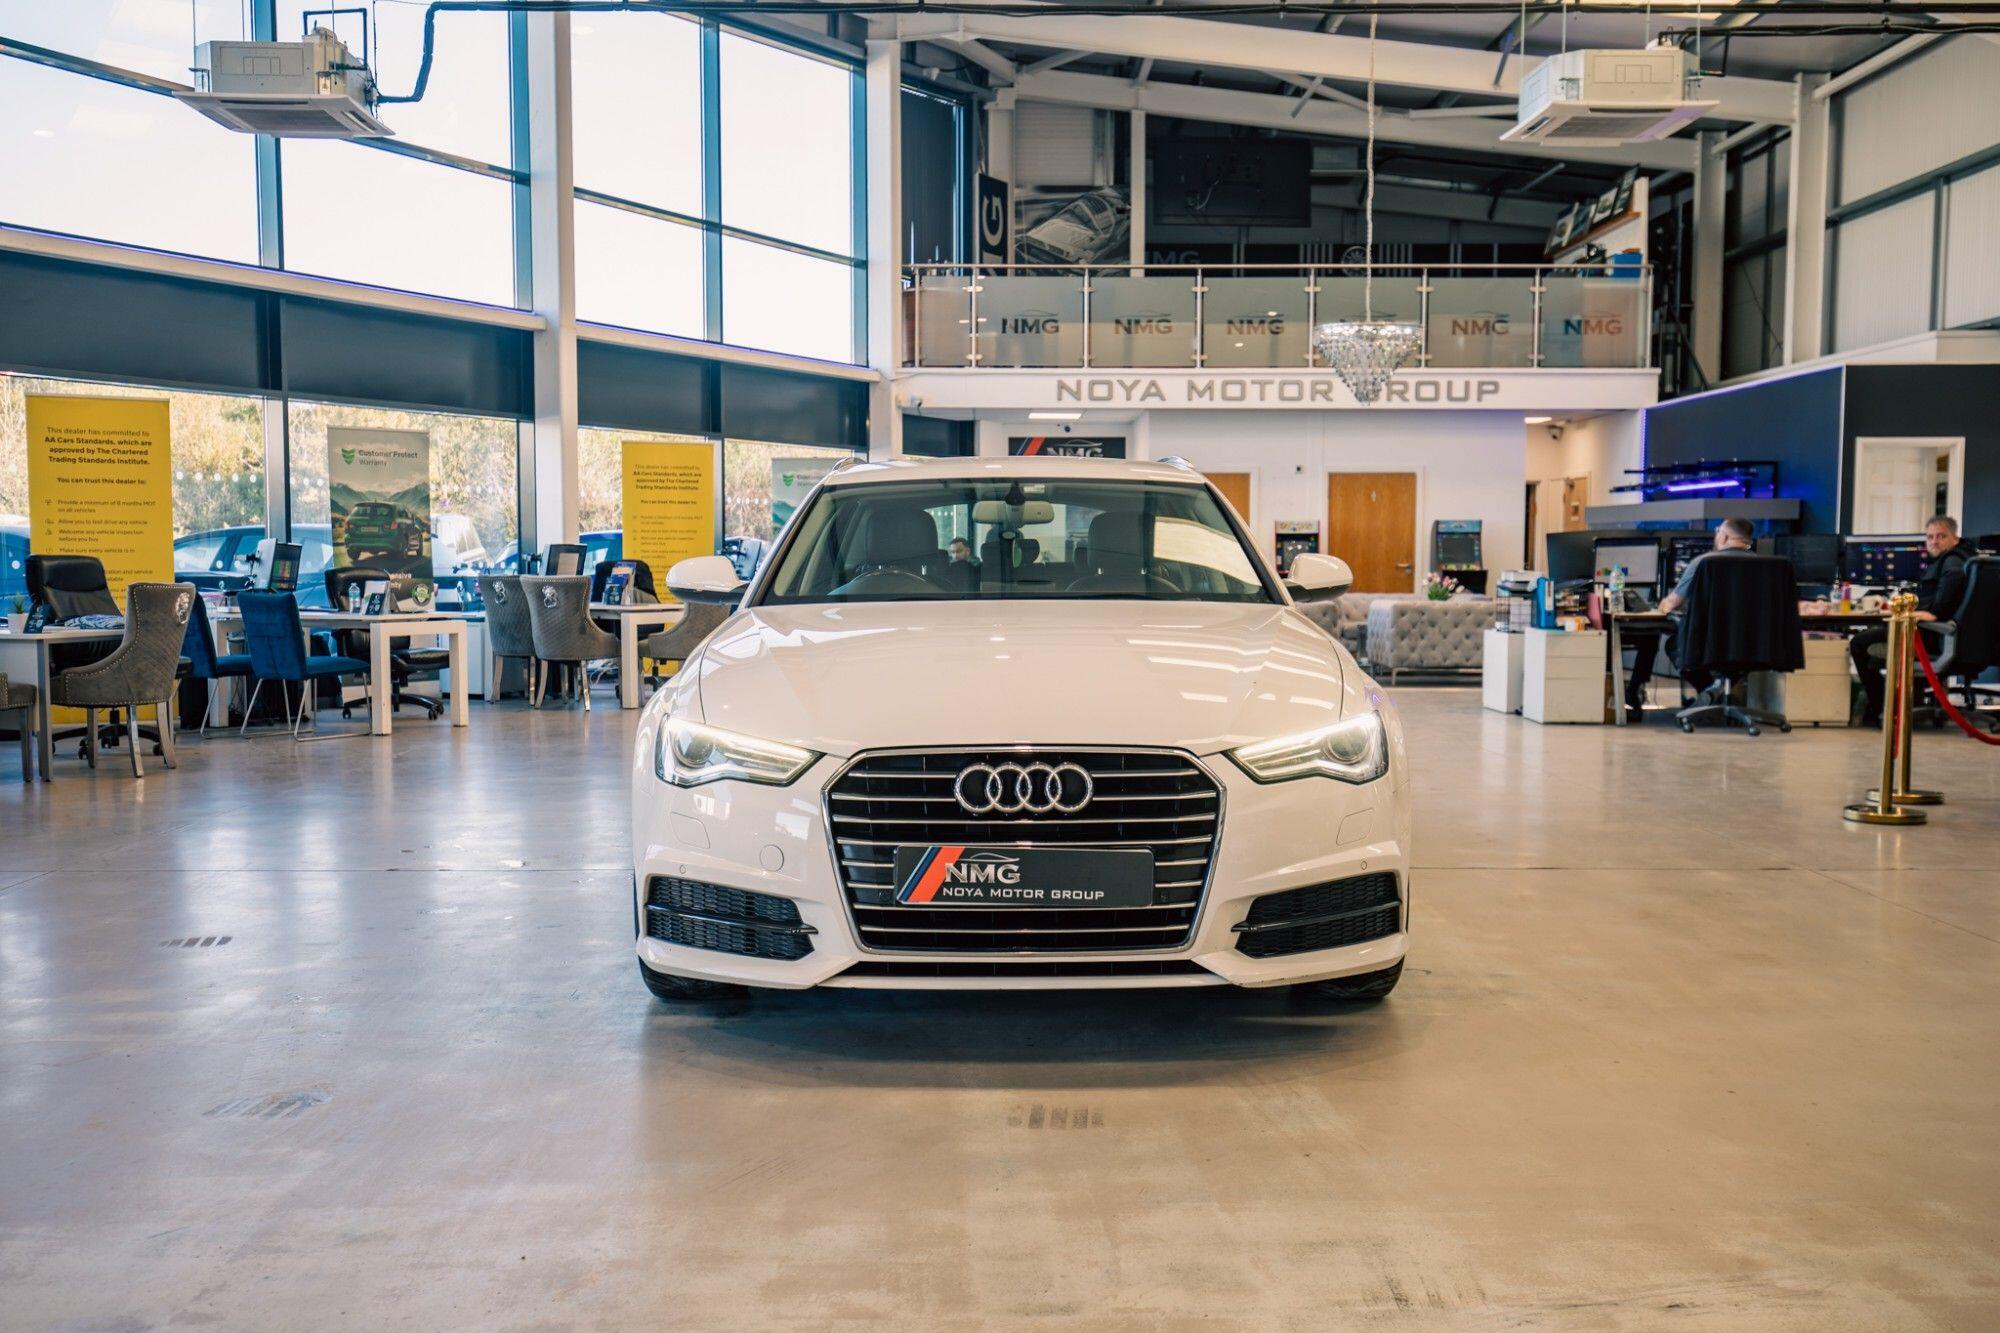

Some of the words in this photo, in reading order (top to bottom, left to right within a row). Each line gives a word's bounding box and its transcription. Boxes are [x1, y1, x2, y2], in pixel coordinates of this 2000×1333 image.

[1145, 251, 1200, 264] MG
[1001, 318, 1059, 334] NMG
[1114, 318, 1173, 335] NMG
[1226, 319, 1284, 335] NMG
[1564, 319, 1622, 335] NMG
[1056, 379, 1167, 401] NOYA
[1187, 379, 1334, 401] MOTOR
[1358, 380, 1500, 402] ROUP
[944, 862, 1021, 884] NMG
[942, 887, 984, 898] NOYA
[990, 888, 1044, 899] MOTOR
[1051, 890, 1105, 900] GROUP
